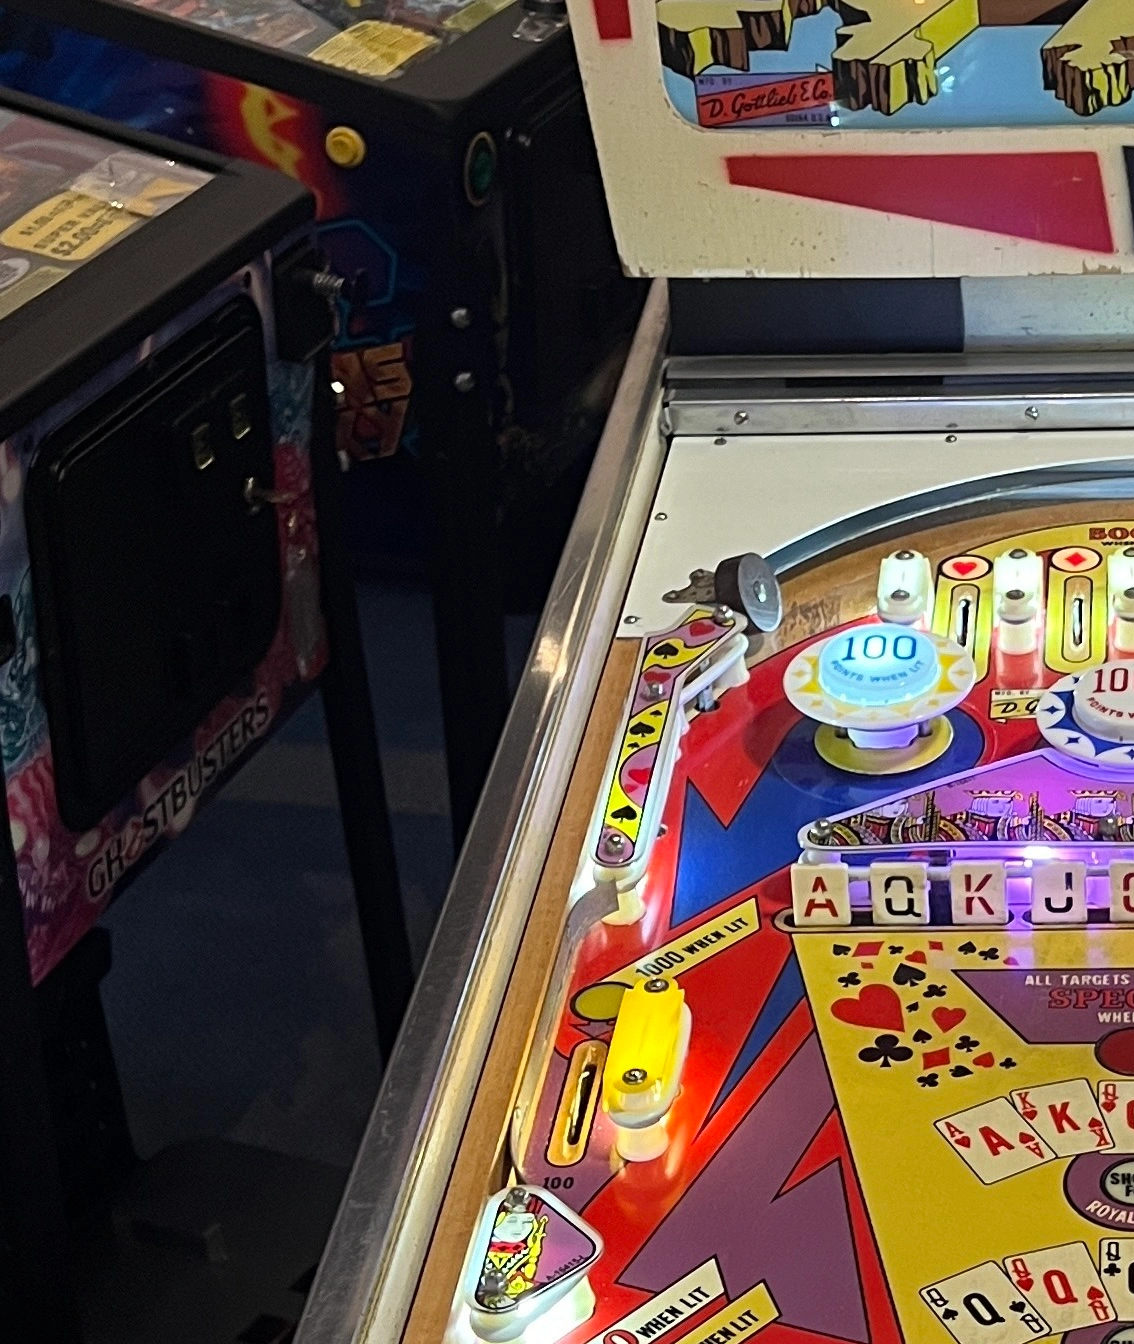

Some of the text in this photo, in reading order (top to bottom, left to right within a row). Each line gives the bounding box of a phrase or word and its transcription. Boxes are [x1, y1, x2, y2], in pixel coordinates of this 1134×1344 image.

[731, 84, 796, 117] Gottlieb
[841, 635, 917, 661] 100
[830, 660, 863, 681] POINTS
[870, 673, 907, 682] WHEN
[1086, 697, 1124, 718] POINTS
[804, 876, 838, 917] A
[884, 876, 921, 917] Q
[964, 874, 994, 915] K
[1044, 872, 1073, 913] J
[636, 918, 749, 977] 1000 WHEN LIT
[1025, 975, 1052, 985] ALL
[1060, 974, 1132, 985] TARGETS
[542, 1176, 574, 1189] 100
[636, 1305, 684, 1340] WHEN
[680, 1286, 710, 1308] LIT
[730, 1310, 760, 1332] LIT
